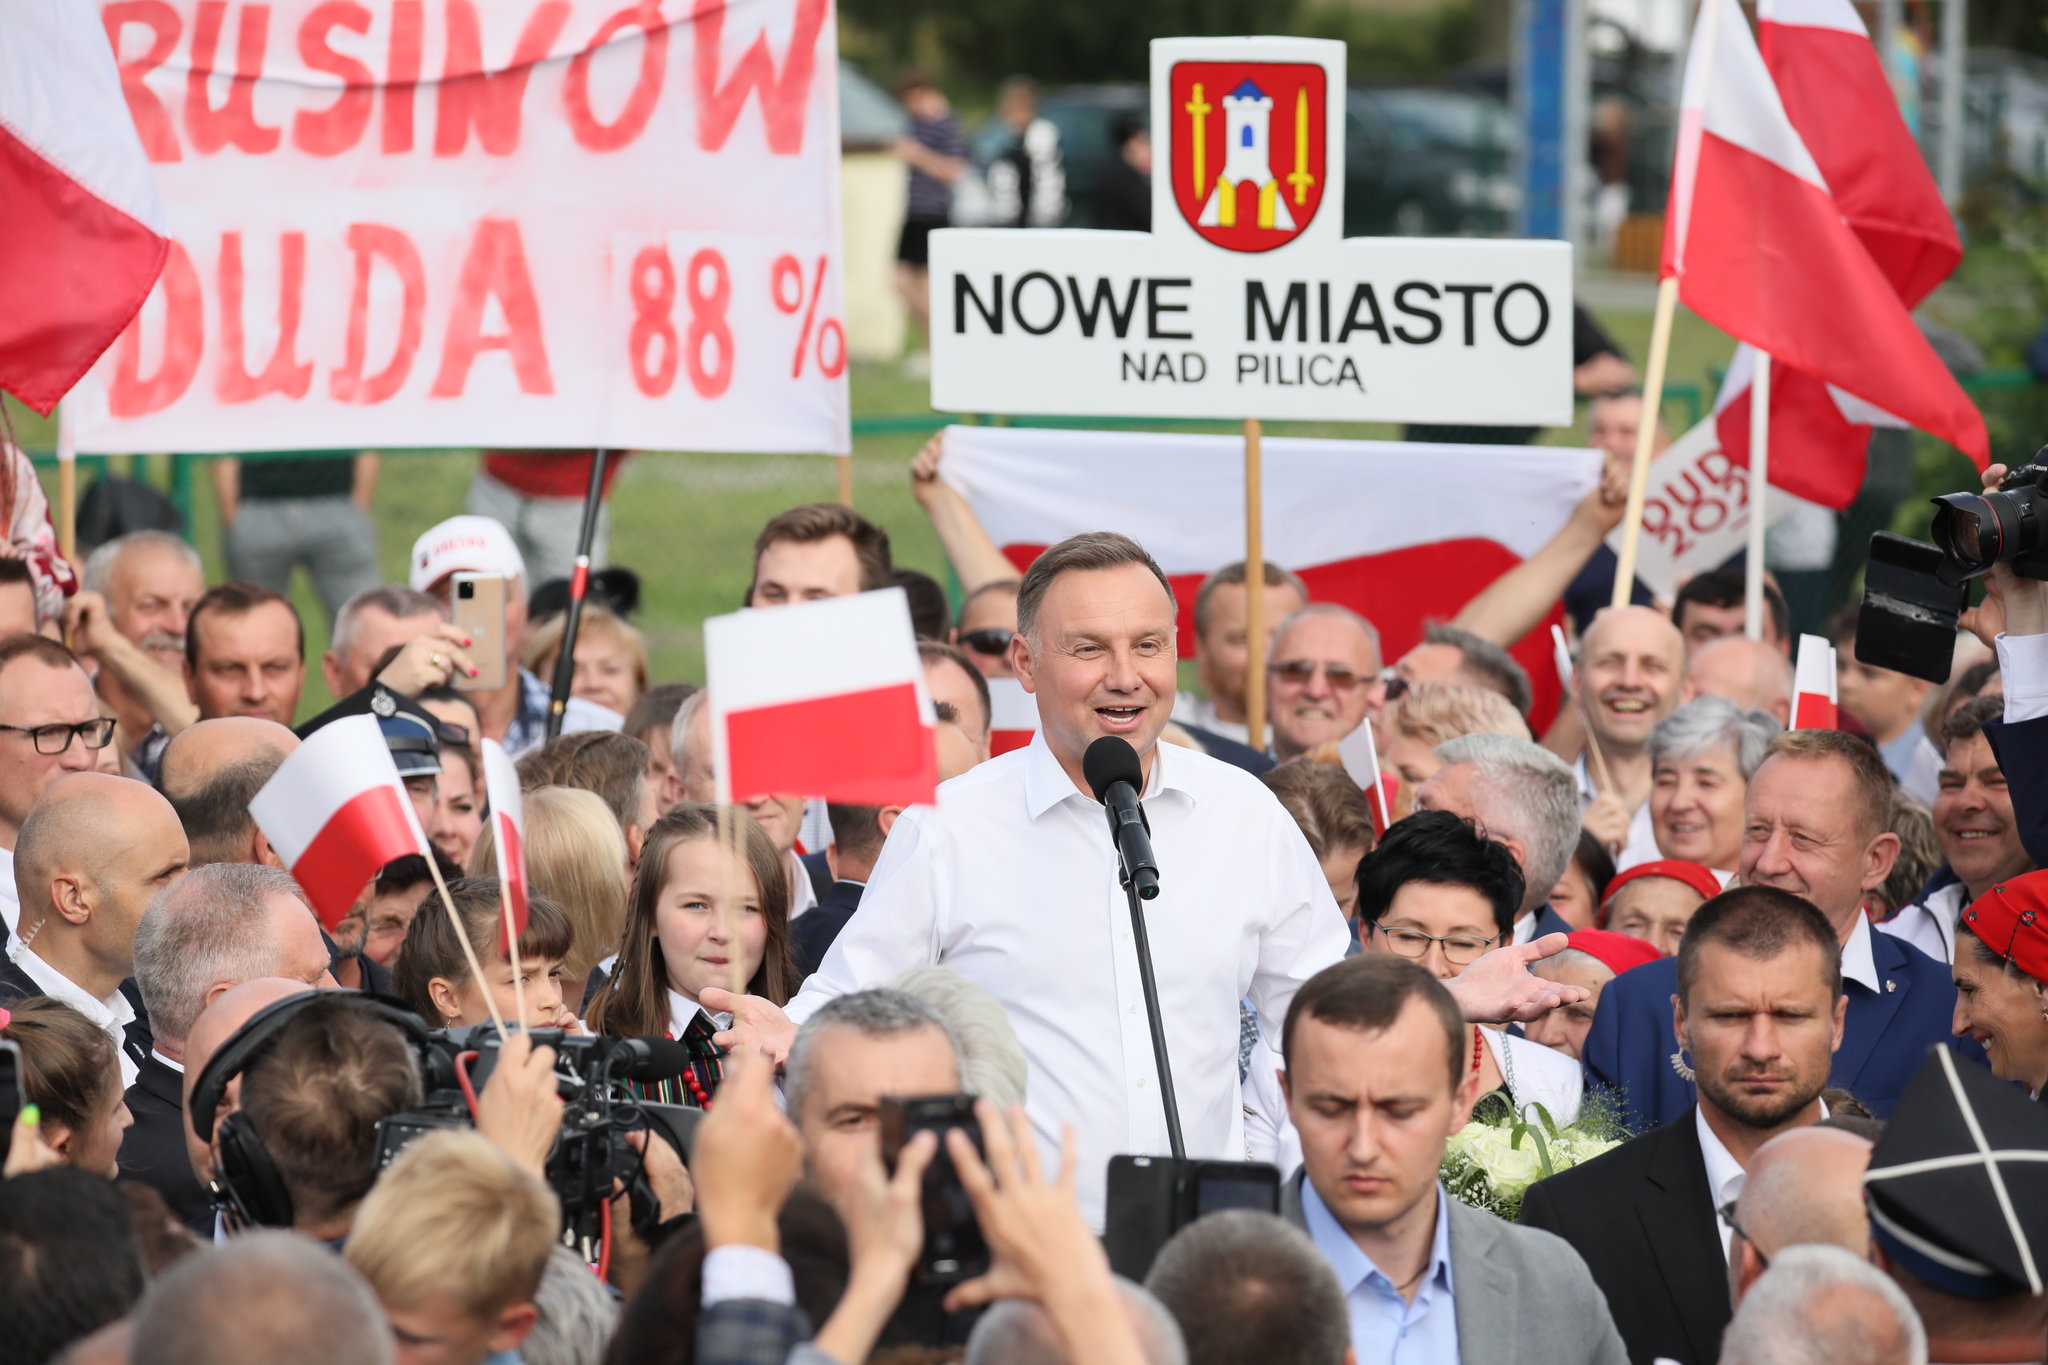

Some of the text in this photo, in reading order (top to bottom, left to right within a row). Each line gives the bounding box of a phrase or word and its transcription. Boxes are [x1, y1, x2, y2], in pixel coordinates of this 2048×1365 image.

[107, 218, 848, 419] DUDA 88 %
[953, 271, 1551, 348] NOWE MIASTO
[1121, 352, 1366, 393] NAD PILICĄ
[1640, 449, 1734, 534] DUD
[1658, 472, 1750, 557] 202
